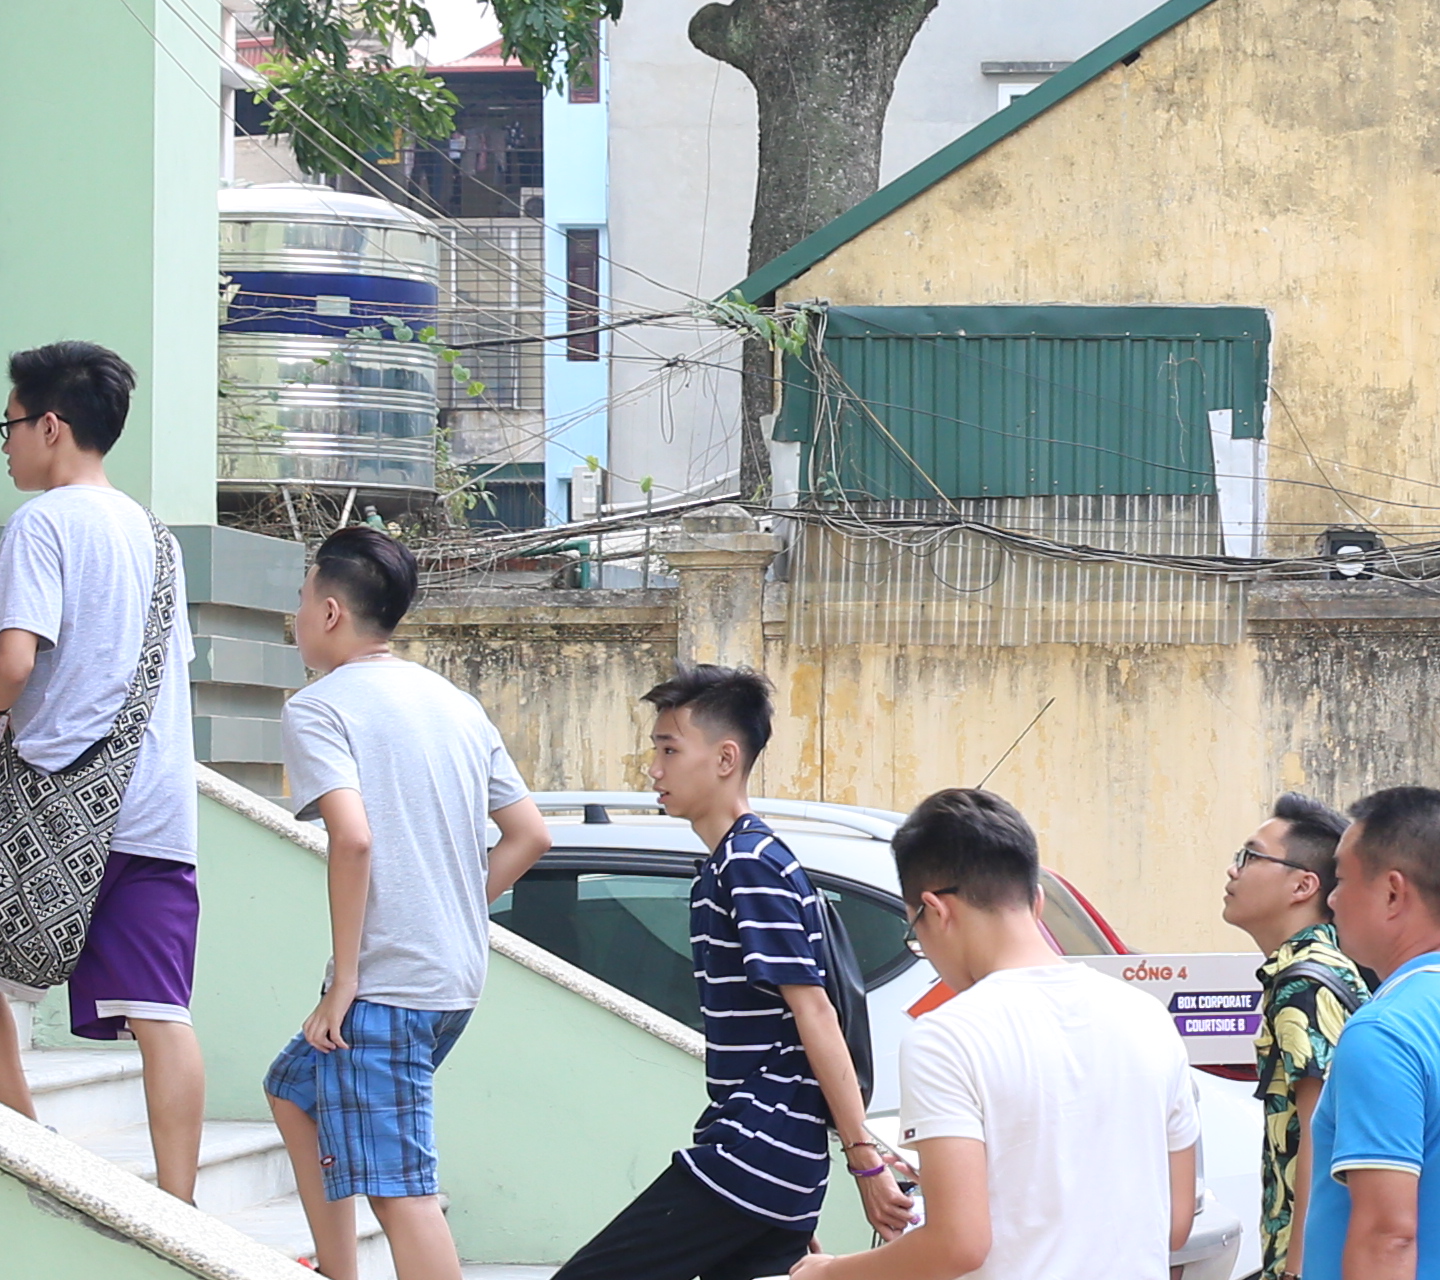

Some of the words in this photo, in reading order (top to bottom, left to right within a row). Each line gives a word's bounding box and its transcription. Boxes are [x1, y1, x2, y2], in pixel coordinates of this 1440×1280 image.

[1122, 959, 1173, 981] CỔNG
[1177, 966, 1188, 980] 4
[1177, 996, 1197, 1010] BOX
[1198, 994, 1252, 1009] CORPORATE
[1185, 1018, 1237, 1033] COURTSIDE
[1237, 1018, 1245, 1032] B
